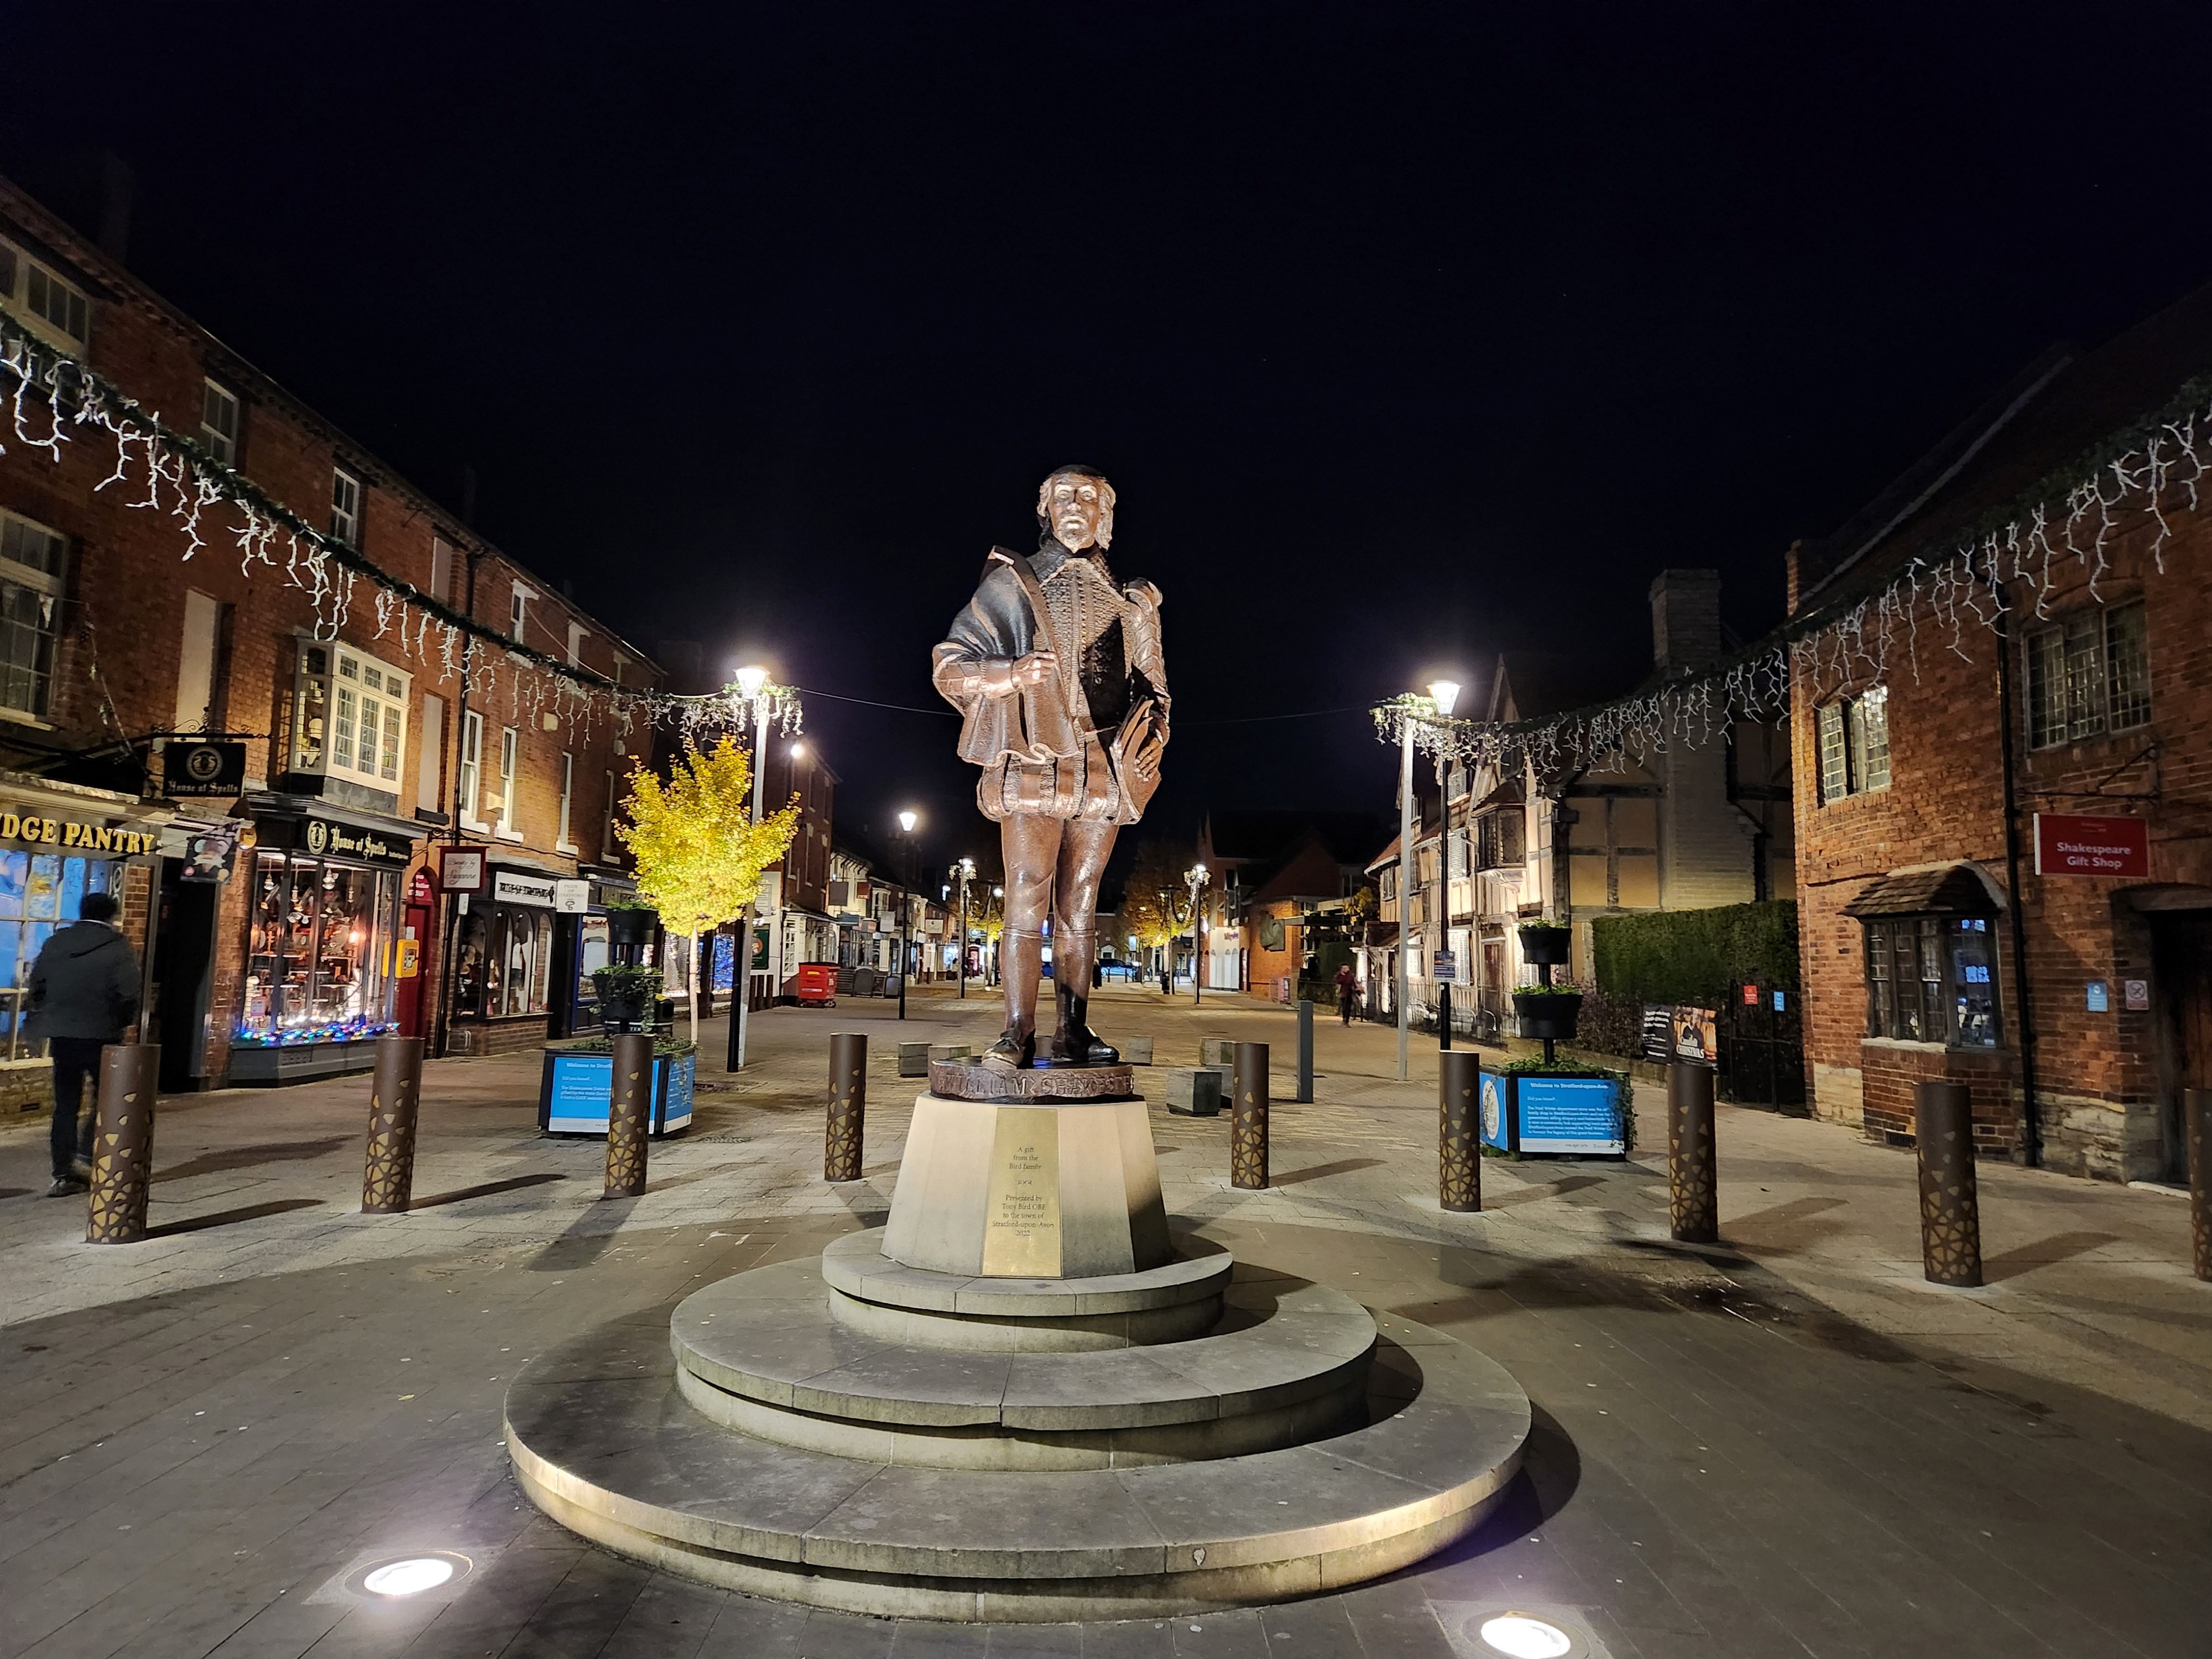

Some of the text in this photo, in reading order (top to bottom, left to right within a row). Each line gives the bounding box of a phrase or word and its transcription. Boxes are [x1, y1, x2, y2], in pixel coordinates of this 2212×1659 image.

[208, 781, 238, 795] Spells
[0, 812, 155, 856] DGE PANTRY
[330, 826, 354, 854] House
[363, 832, 387, 860] Spells
[2057, 842, 2131, 855] Shakespeare
[2067, 856, 2122, 870] Gift Shop
[1023, 1163, 1042, 1171] family
[992, 1220, 1054, 1229] Stratford-upon-Avon
